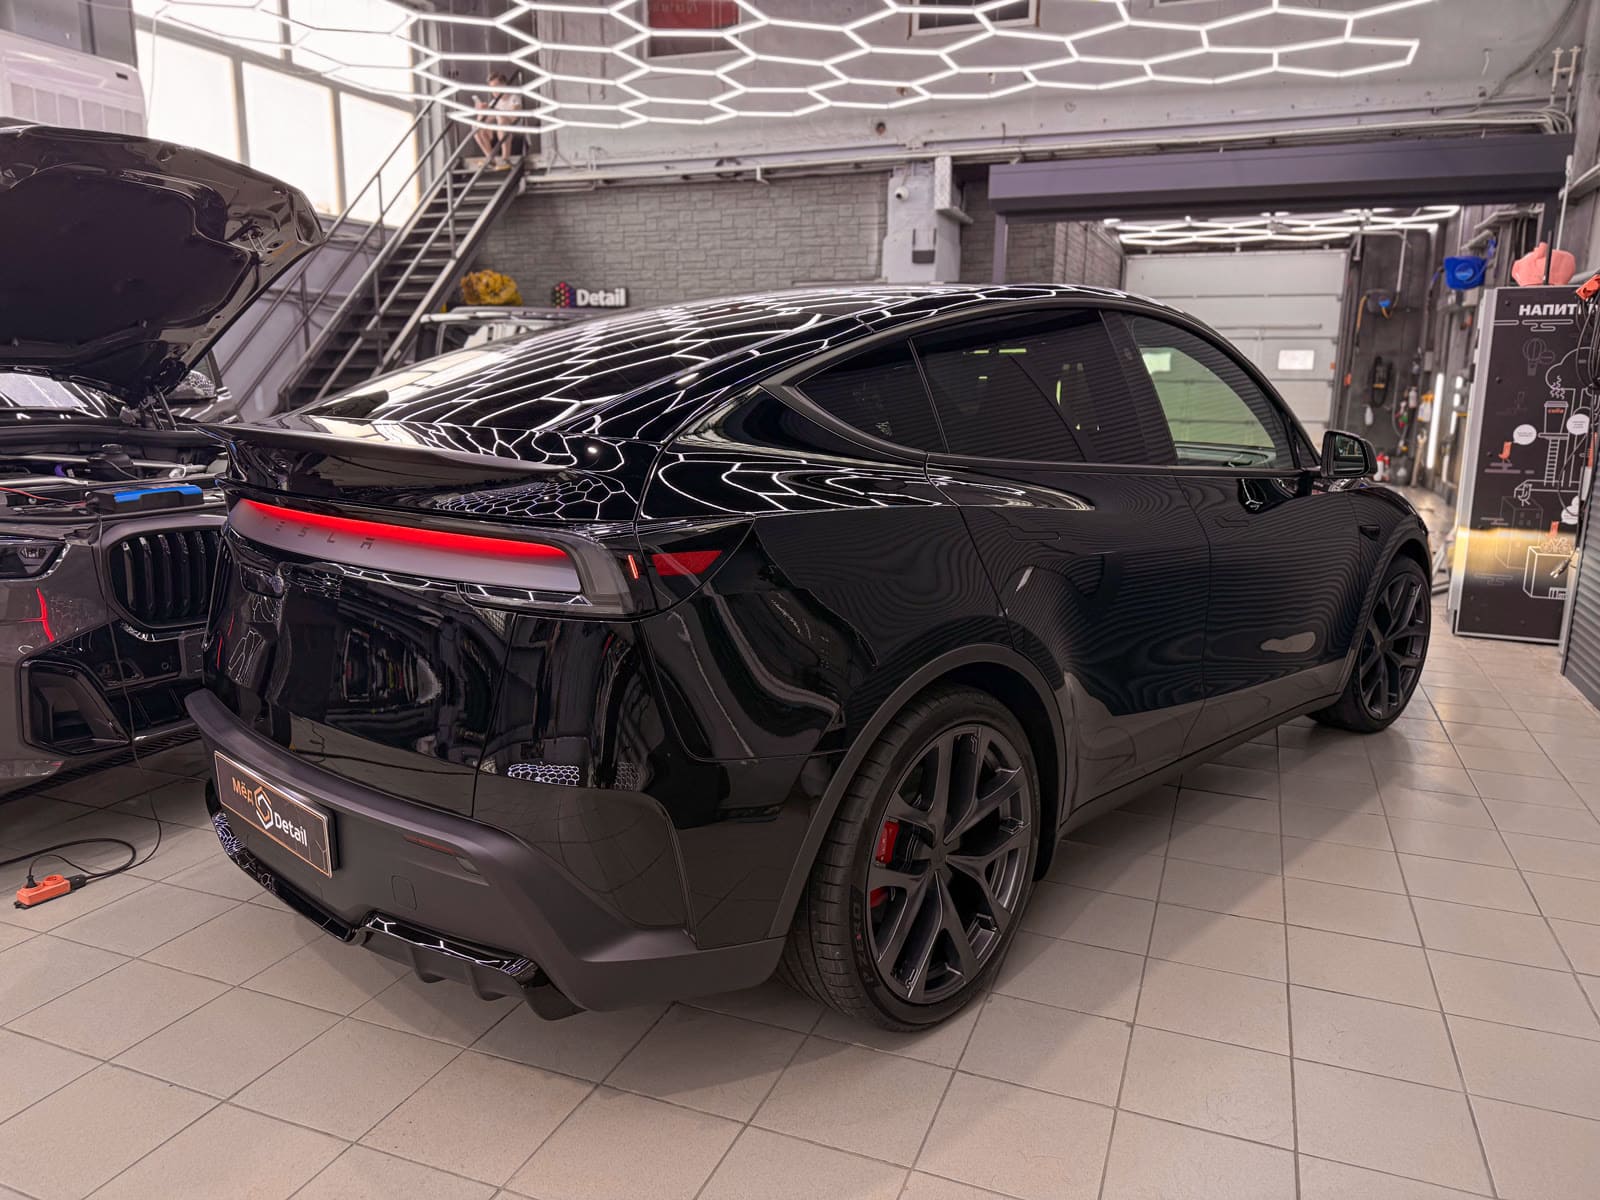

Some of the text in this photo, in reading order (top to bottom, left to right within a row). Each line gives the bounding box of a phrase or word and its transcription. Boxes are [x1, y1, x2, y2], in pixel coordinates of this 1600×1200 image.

[576, 288, 626, 306] Detail
[232, 777, 255, 806] Мёд
[274, 811, 308, 847] Detail
